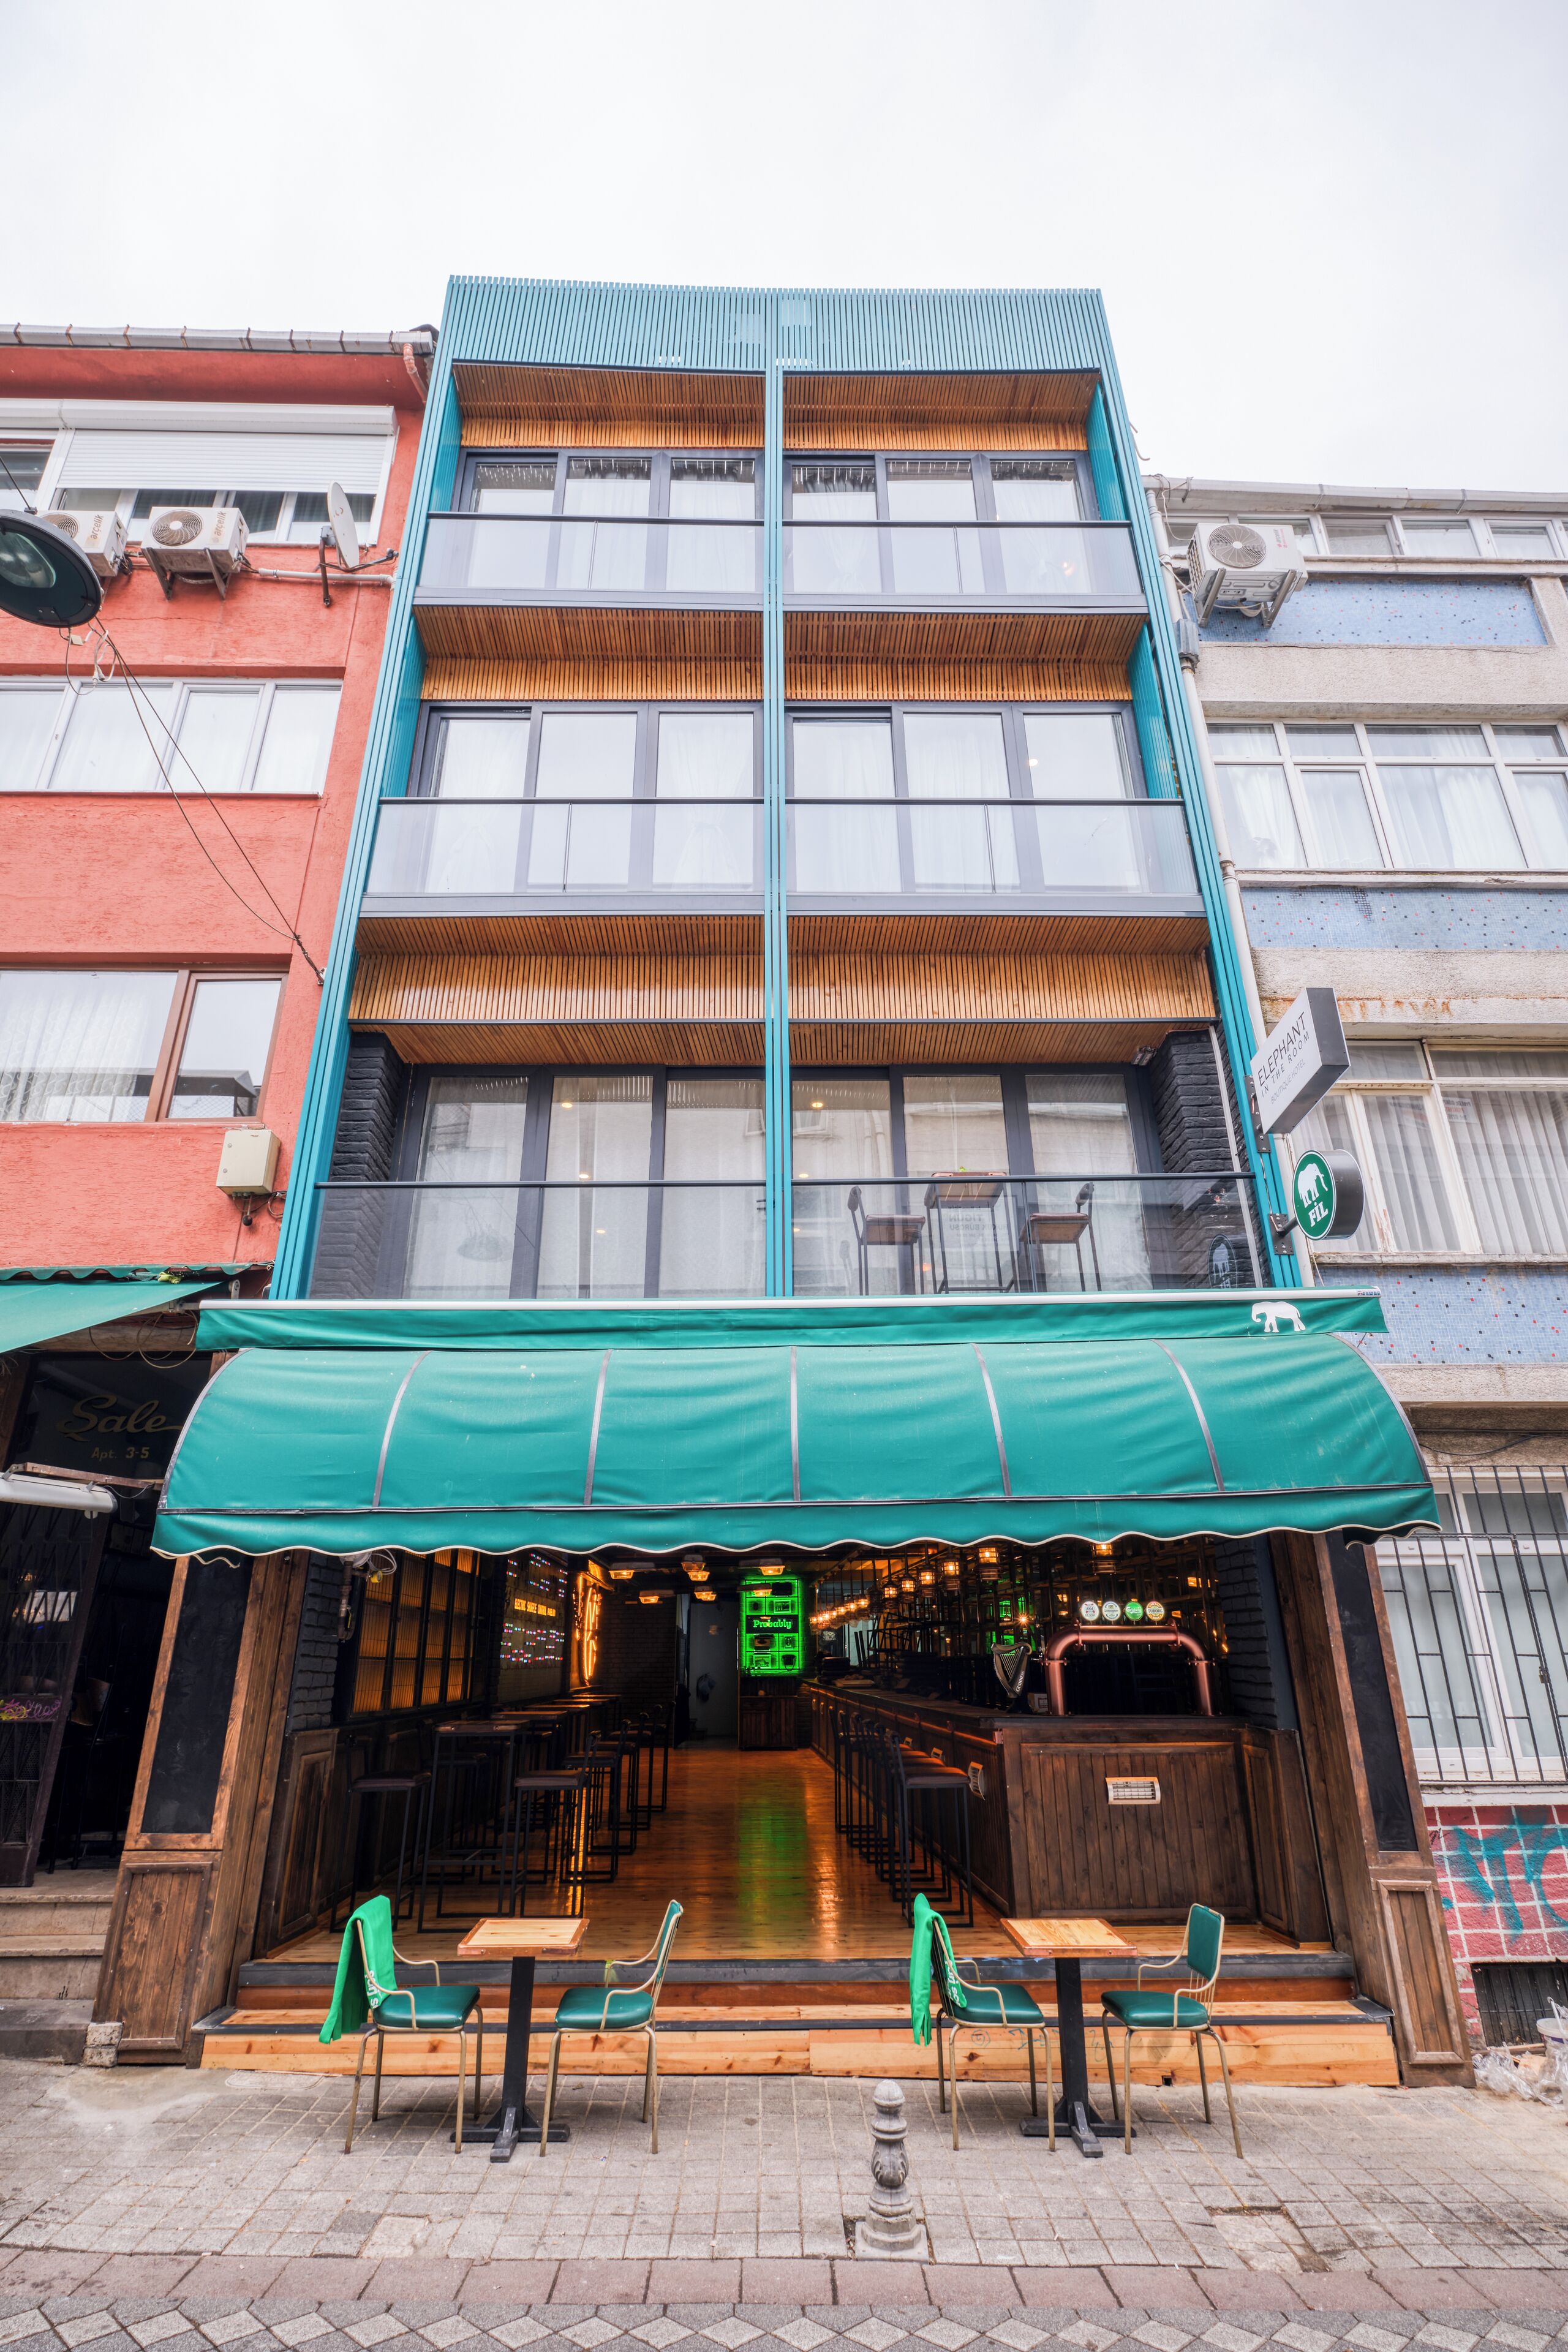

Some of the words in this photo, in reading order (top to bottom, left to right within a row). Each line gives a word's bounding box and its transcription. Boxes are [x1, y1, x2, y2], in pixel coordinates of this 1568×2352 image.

[90, 514, 104, 540] arçelik
[214, 511, 227, 536] arçelik
[1257, 1012, 1305, 1087] ELEPHANT
[1261, 1084, 1269, 1098] IN
[1272, 1063, 1285, 1084] THE
[1287, 1031, 1310, 1063] ROOM
[1270, 1074, 1292, 1104] BOUTIQUE
[1291, 1058, 1306, 1079] HOTEL
[1308, 1201, 1329, 1227] FİL
[92, 1447, 117, 1461] Apt.
[126, 1447, 149, 1459] 3-5
[753, 1619, 791, 1629] Probably
[1016, 1671, 1024, 1692] GUINNESS
